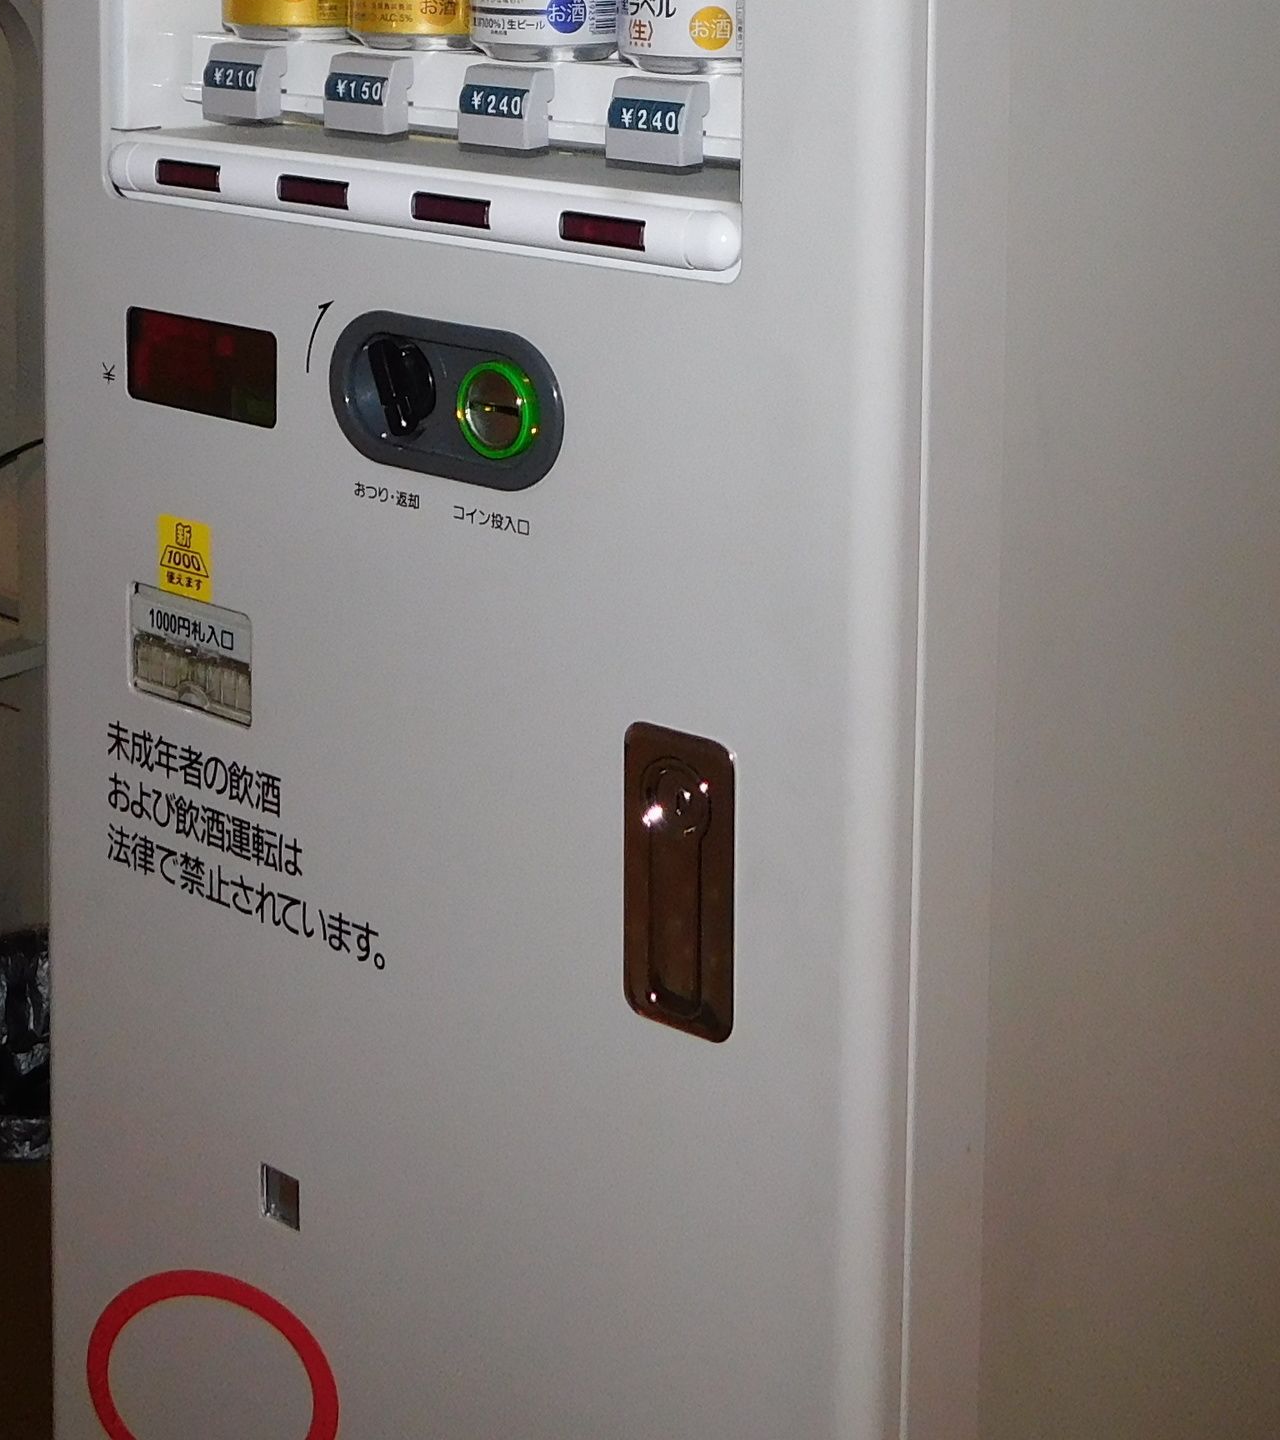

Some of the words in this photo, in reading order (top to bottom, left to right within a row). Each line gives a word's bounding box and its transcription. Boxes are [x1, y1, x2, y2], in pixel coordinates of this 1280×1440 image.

[548, 4, 586, 23] お酒
[691, 18, 732, 39] お酒
[213, 67, 256, 88] ¥210
[336, 79, 382, 100] ¥150
[471, 91, 521, 115] ¥240
[621, 109, 677, 132] ¥240
[353, 480, 420, 510] おつり・返却
[453, 504, 530, 536] コイン投入口
[175, 523, 192, 549] 新
[166, 549, 201, 571] 1000
[149, 607, 234, 651] 1000円札入口
[107, 720, 282, 818] 未成年者の飲酒
[108, 772, 304, 877] および飲酒運転は
[107, 824, 386, 970] 法律で禁止されています。
